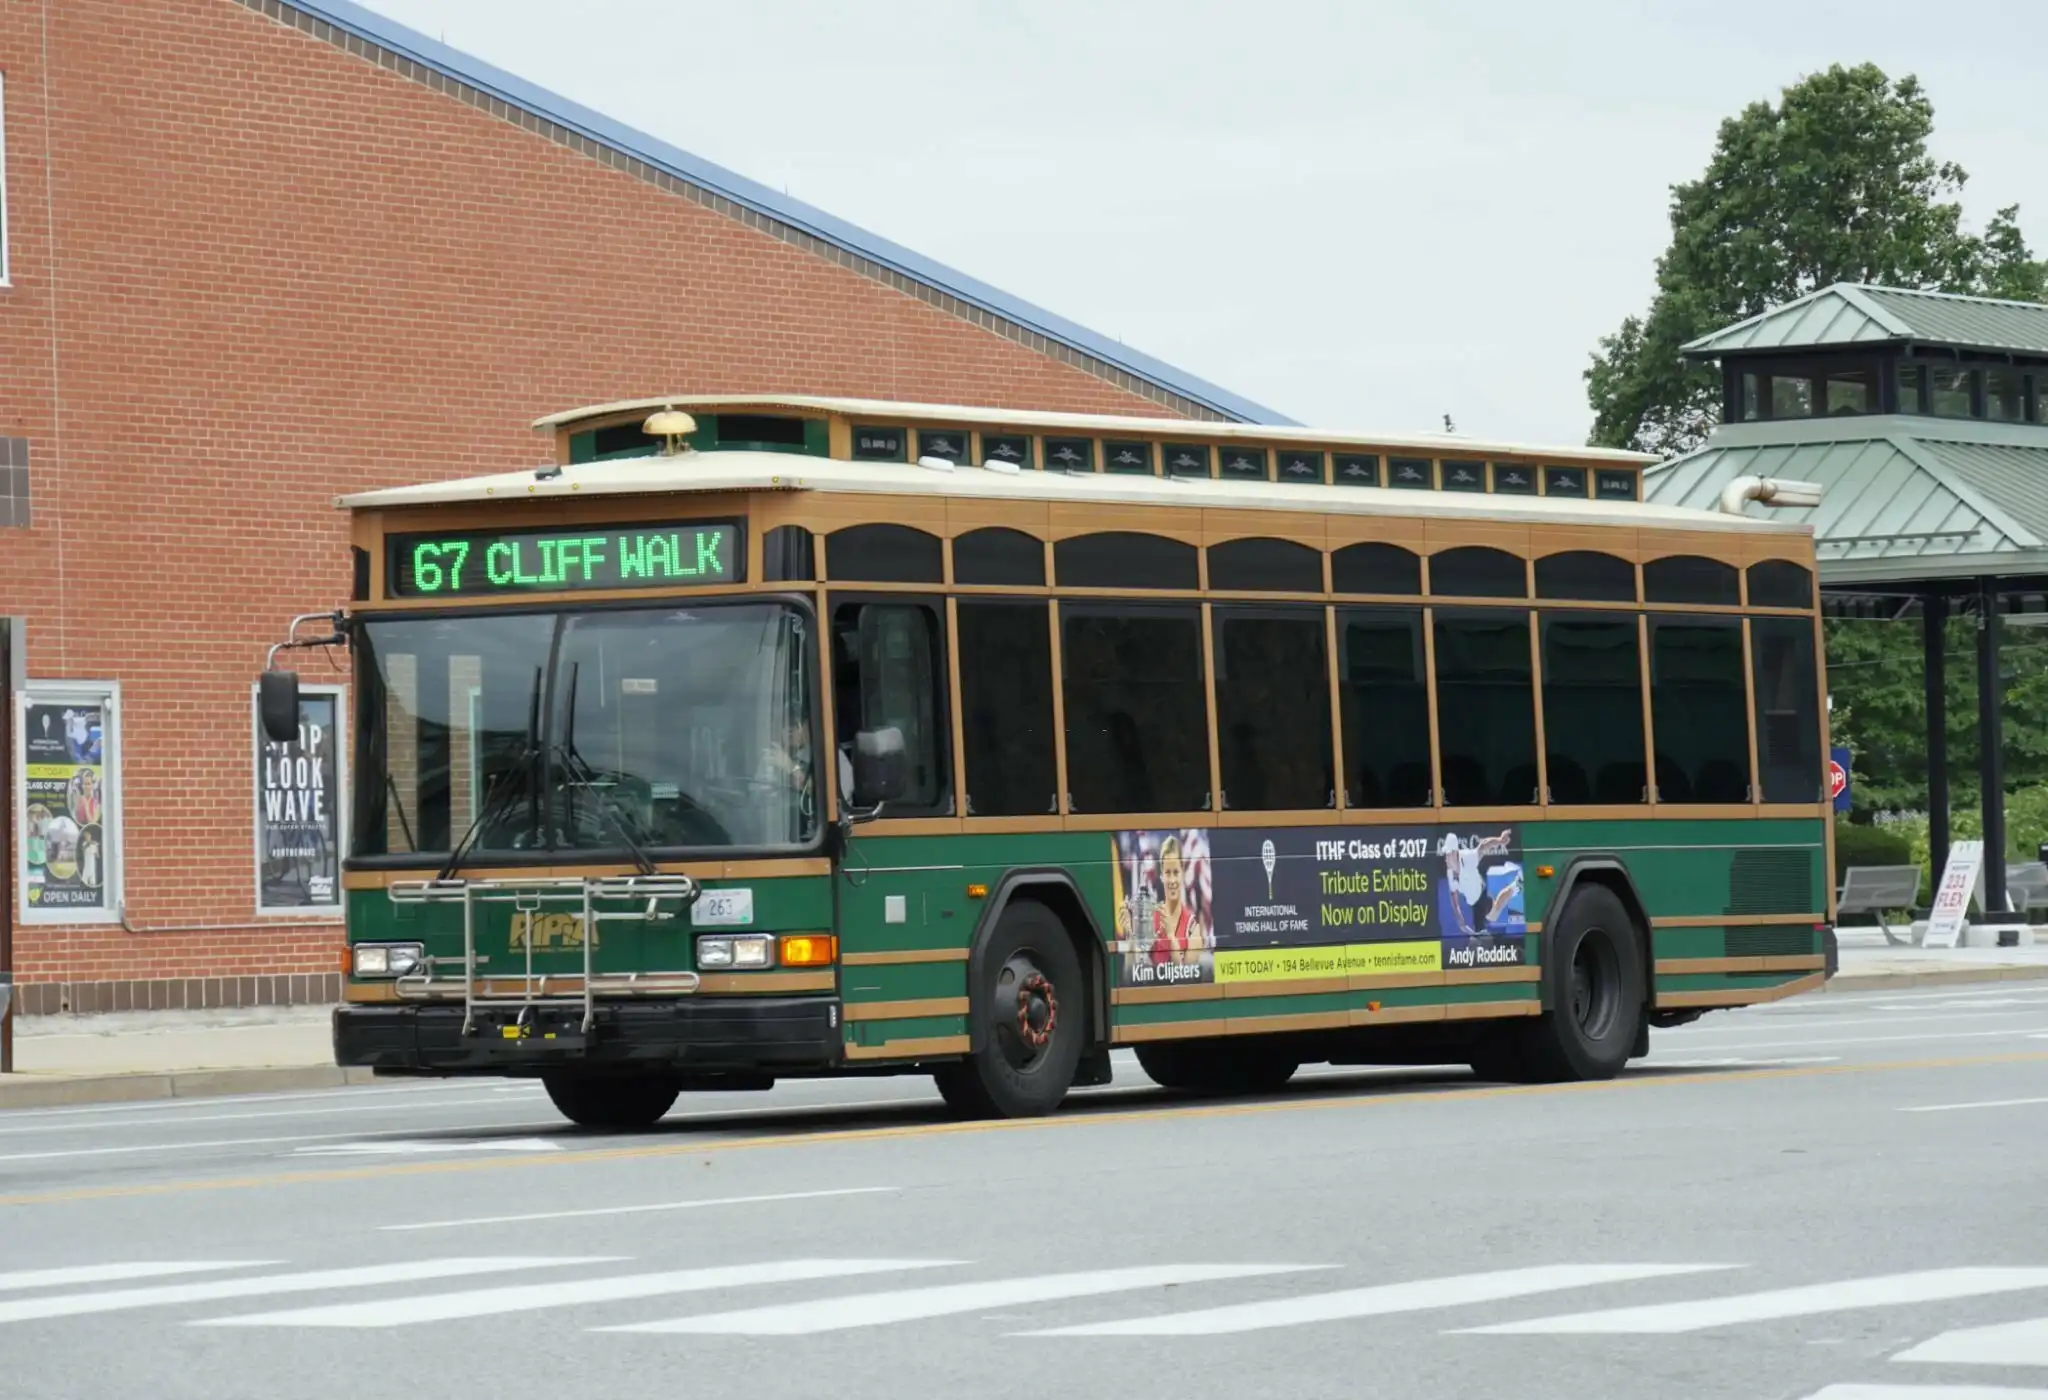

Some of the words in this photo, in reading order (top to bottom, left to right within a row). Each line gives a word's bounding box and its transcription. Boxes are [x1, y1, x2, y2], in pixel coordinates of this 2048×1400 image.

[414, 541, 469, 591] 67
[487, 537, 607, 585] CLIFF
[618, 531, 723, 579] WALK
[266, 757, 324, 789] LOOK
[265, 789, 325, 822] WAVE
[1316, 840, 1346, 861] ITHF
[1348, 839, 1381, 860] Class
[1383, 838, 1397, 858] of
[1399, 838, 1428, 858] 2017
[1319, 870, 1369, 895] Tribute
[1372, 868, 1427, 893] Exhibits
[43, 889, 70, 903] OPEN
[70, 890, 97, 903] DAILY
[1937, 891, 1964, 908] FLEX
[1244, 904, 1298, 917] INTERNATIONAL
[1321, 903, 1353, 927] Now
[1357, 905, 1375, 925] on
[1378, 898, 1428, 927] Display
[1234, 921, 1259, 933] TENNIS
[1260, 920, 1278, 932] HALL
[1279, 919, 1289, 932] OF
[1289, 919, 1309, 931] FAME
[1220, 962, 1241, 976] VISIT
[1245, 960, 1273, 975] TODAY
[1282, 960, 1297, 973] 194
[1299, 957, 1334, 972] Bellevue
[1337, 956, 1366, 969] Avenue
[1374, 952, 1435, 966] tennisfame.com
[1449, 946, 1474, 967] Andy
[1477, 945, 1517, 964] Roddick
[1132, 963, 1154, 982] Kim
[1156, 962, 1201, 983] Clijsters
